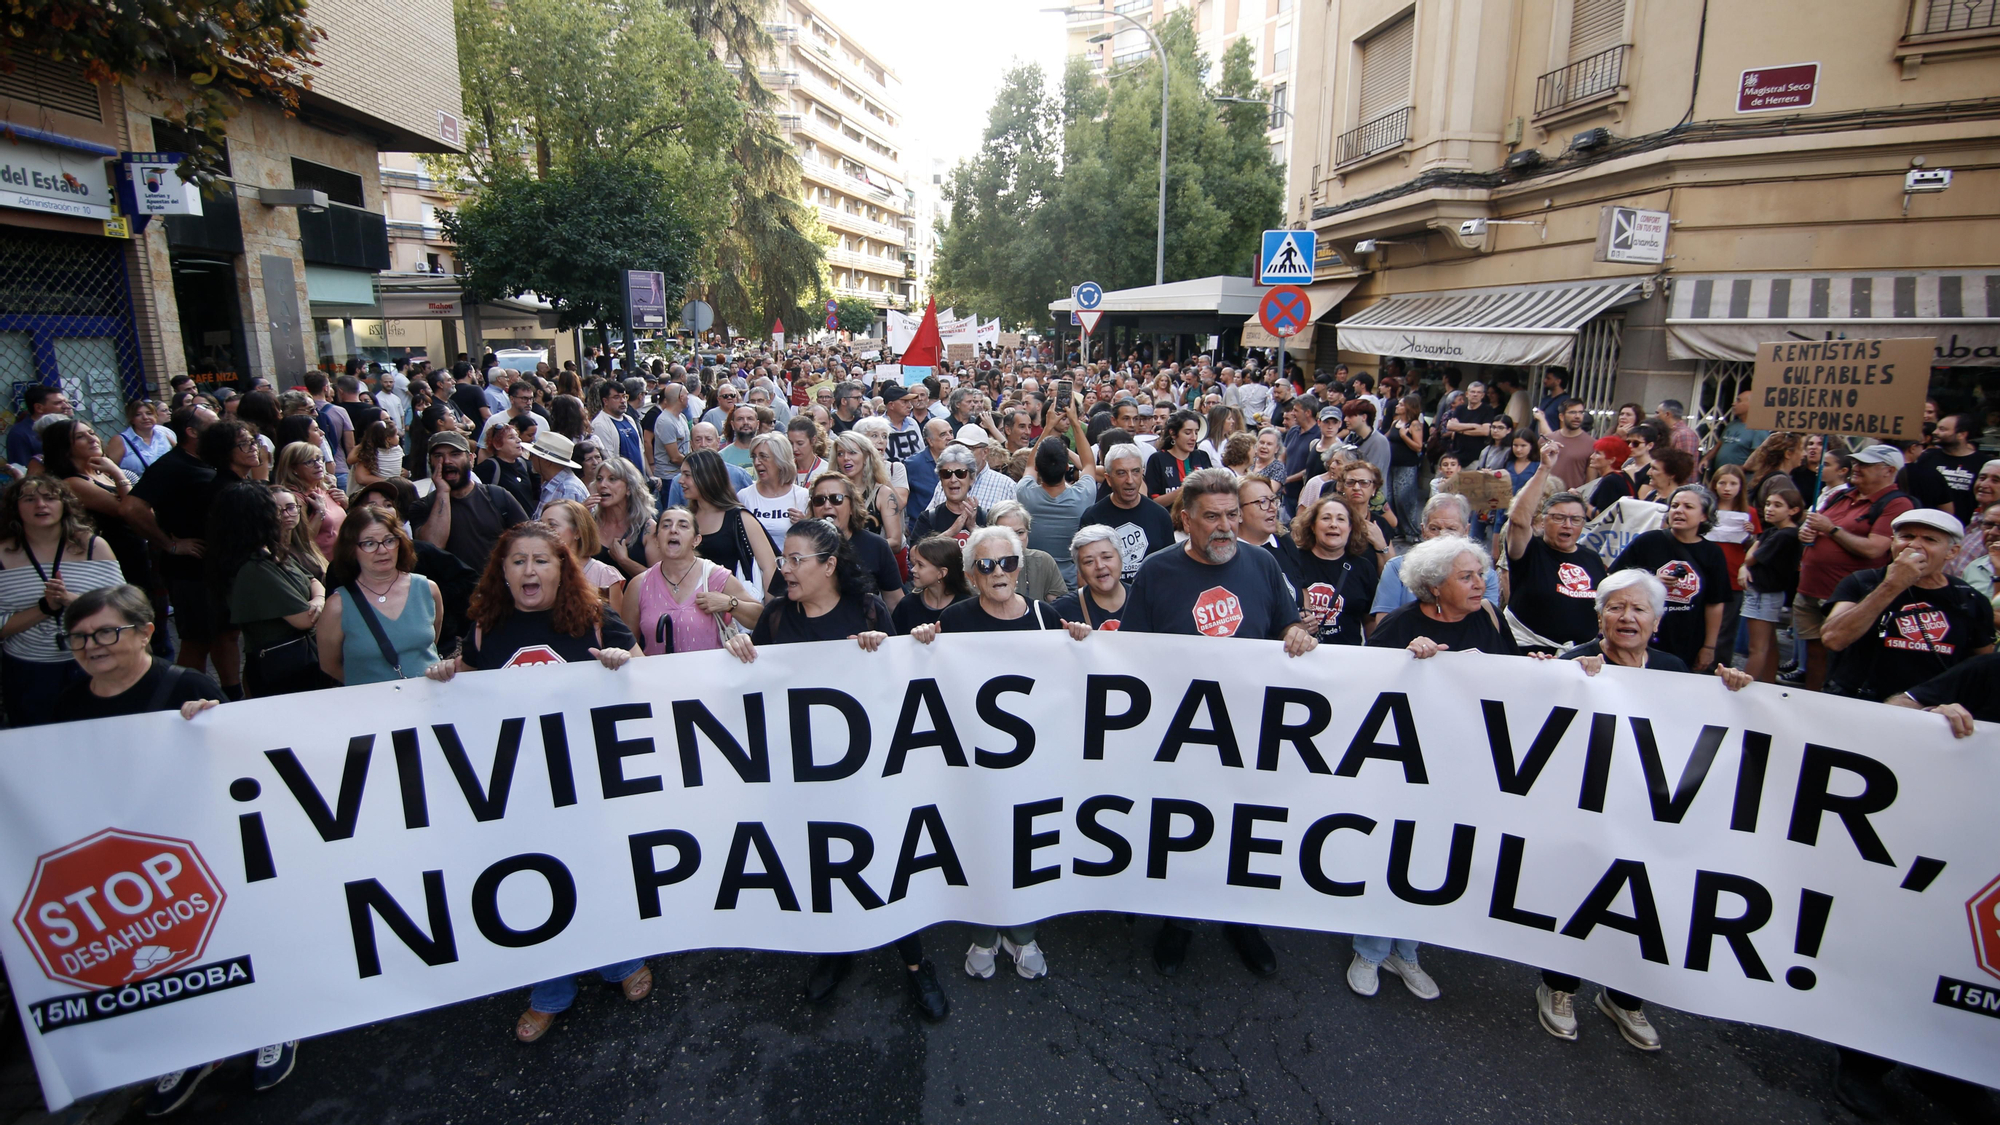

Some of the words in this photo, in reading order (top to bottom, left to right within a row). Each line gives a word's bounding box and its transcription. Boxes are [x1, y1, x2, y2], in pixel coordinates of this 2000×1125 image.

[1743, 84, 1786, 96] Magistral
[1787, 82, 1811, 92] Seco
[1750, 98, 1763, 106] de
[1765, 95, 1800, 105] Herrera
[1, 164, 28, 186] del
[18, 196, 73, 213] Administración
[82, 206, 92, 215] 10
[1400, 334, 1464, 356] Karamba
[215, 371, 239, 382] NIZA
[1782, 363, 1896, 385] CULPABLES
[1774, 410, 1904, 435] RESPONSABLE
[753, 507, 790, 519] hello
[1121, 530, 1141, 549] TOP
[1196, 596, 1237, 625] STOP
[1309, 592, 1335, 608] STO
[1200, 614, 1241, 631] DESAHUCIOS
[1887, 639, 1906, 649] 15M
[1907, 641, 1952, 654] CÓROBA
[229, 674, 1036, 884] ¡VIVIENDAS
[1084, 674, 1430, 785] PARA
[1480, 699, 1947, 893] VIVIR,
[38, 852, 183, 948] STOP
[344, 852, 577, 979] NO
[628, 803, 969, 920] PARA
[1012, 794, 1834, 993] ESPECULAR!
[60, 892, 210, 976] DESAHUCIOS
[32, 998, 89, 1028] 15M
[96, 961, 248, 1013] CÓRDOBA
